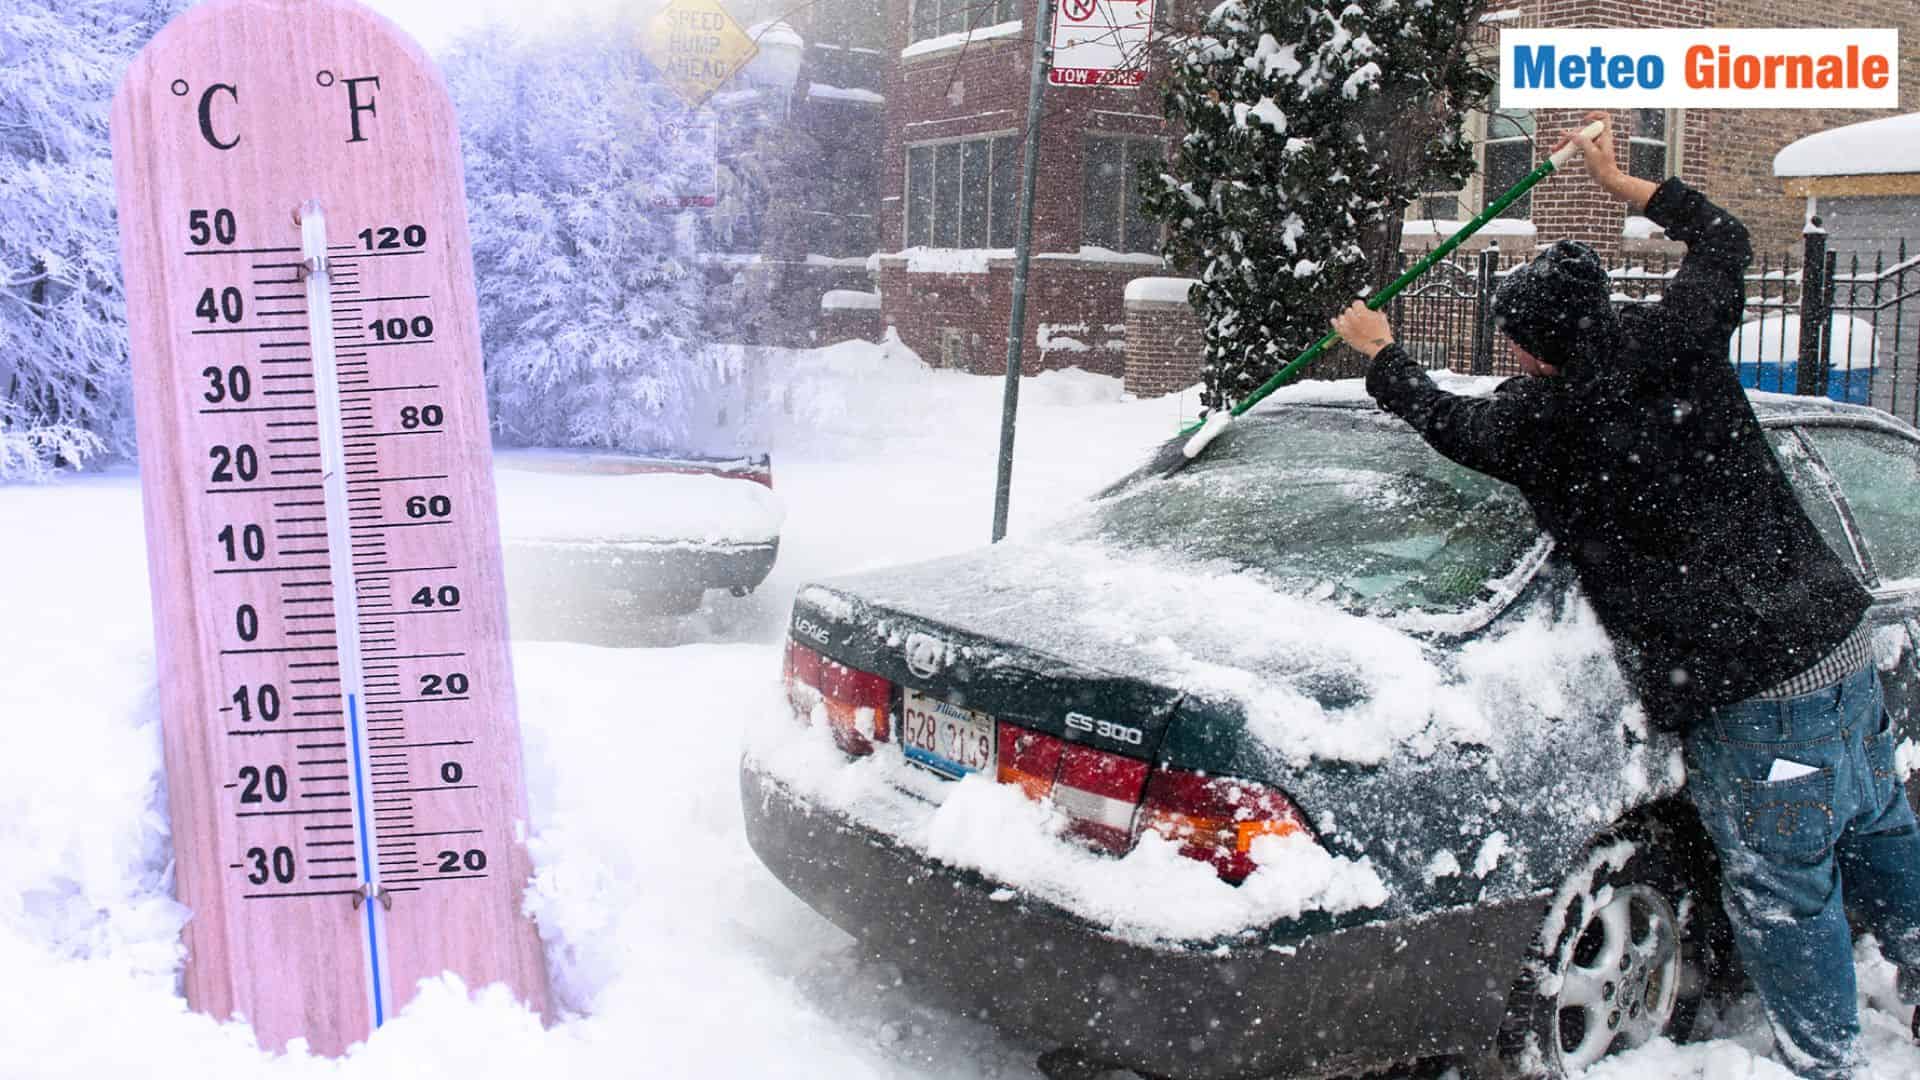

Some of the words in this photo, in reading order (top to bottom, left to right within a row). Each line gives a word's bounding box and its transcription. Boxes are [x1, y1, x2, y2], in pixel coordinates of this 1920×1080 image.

[1055, 69, 1089, 83] TOW
[1095, 70, 1138, 84] ZONE
[190, 208, 237, 246] 50
[358, 225, 427, 250] 120
[196, 287, 244, 324] 40
[368, 316, 434, 341] 100
[203, 366, 251, 403] 30
[400, 405, 444, 429] 80
[210, 444, 259, 482] 20
[406, 495, 452, 518] 60
[217, 524, 266, 562] 10
[411, 585, 461, 607] 40
[236, 604, 259, 642] 0
[420, 673, 469, 696] 20
[219, 684, 281, 723] -10
[905, 707, 936, 752] G28
[1065, 711, 1094, 733] ES
[1096, 719, 1143, 745] 300
[224, 765, 288, 803] -20
[441, 761, 463, 783] 0
[230, 846, 296, 885] -30
[422, 849, 487, 873] -20
